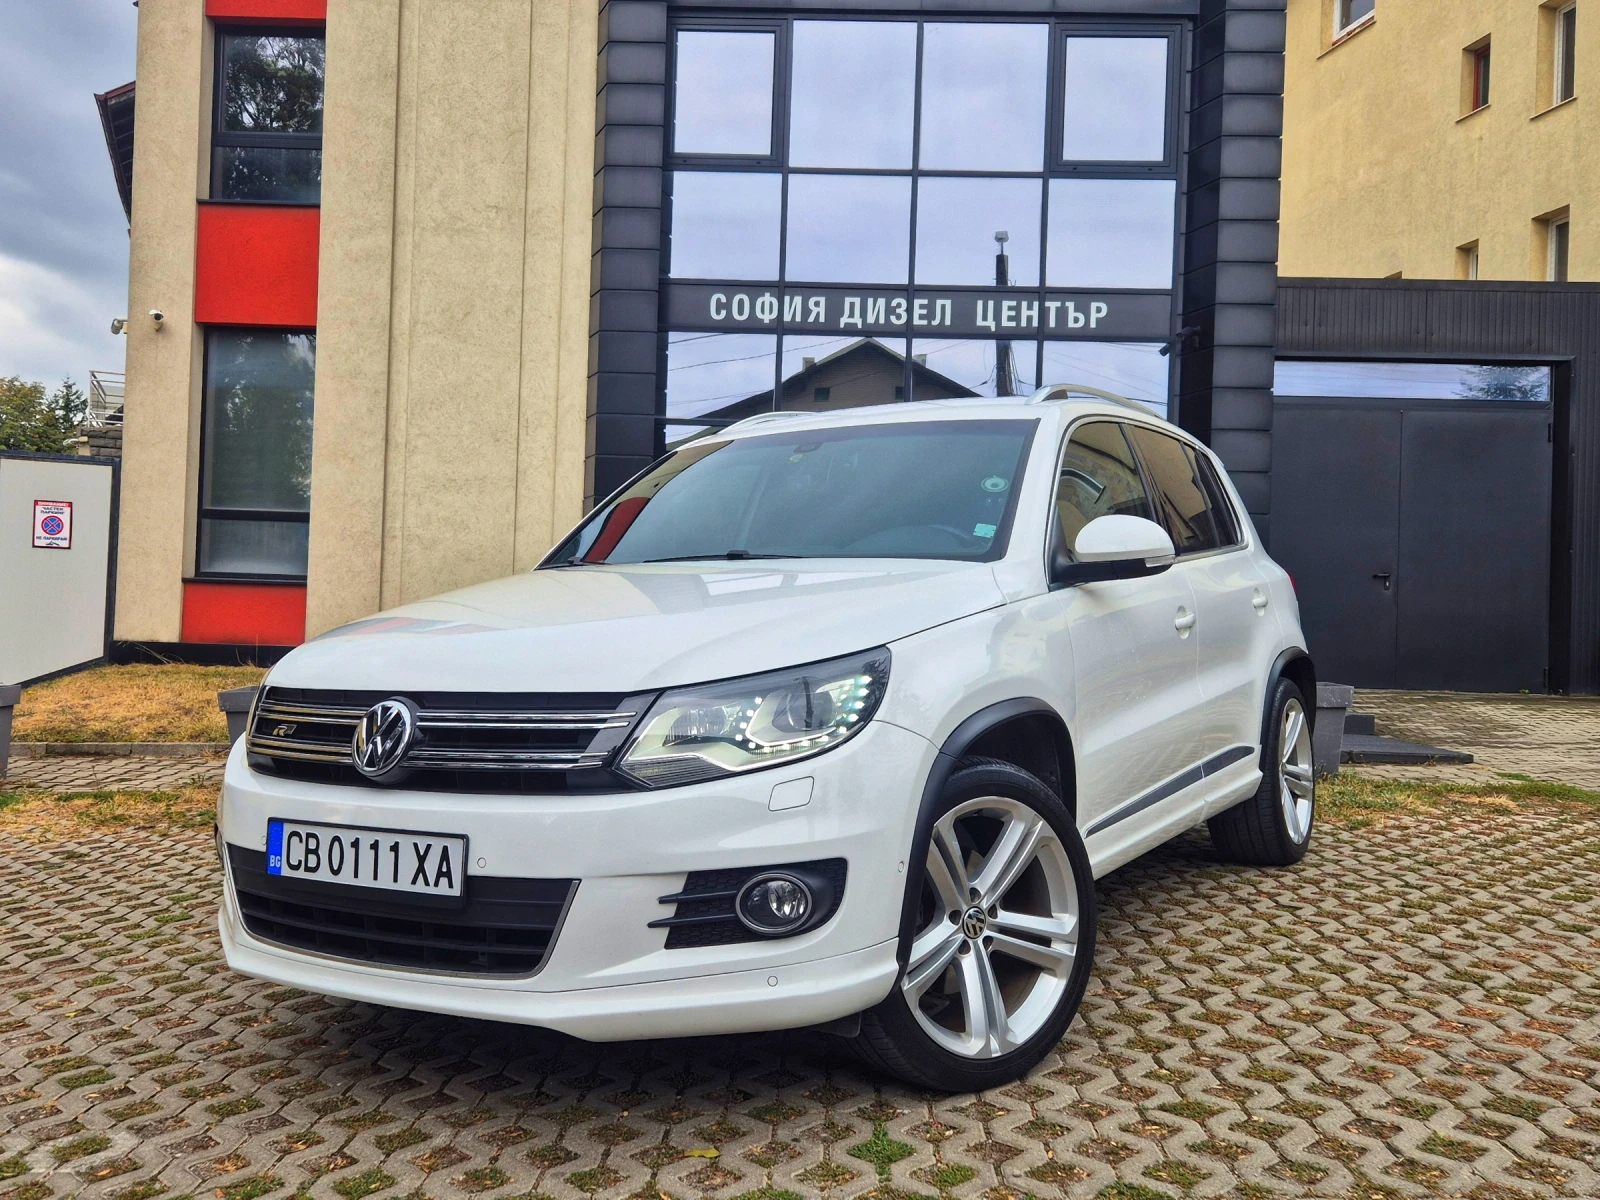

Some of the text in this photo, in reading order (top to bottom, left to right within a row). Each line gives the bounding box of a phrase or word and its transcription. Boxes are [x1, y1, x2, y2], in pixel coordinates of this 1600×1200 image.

[709, 292, 1108, 332] СОФИЯ ДИЗЕЛ ЦЕНТЪР
[269, 854, 281, 868] BG
